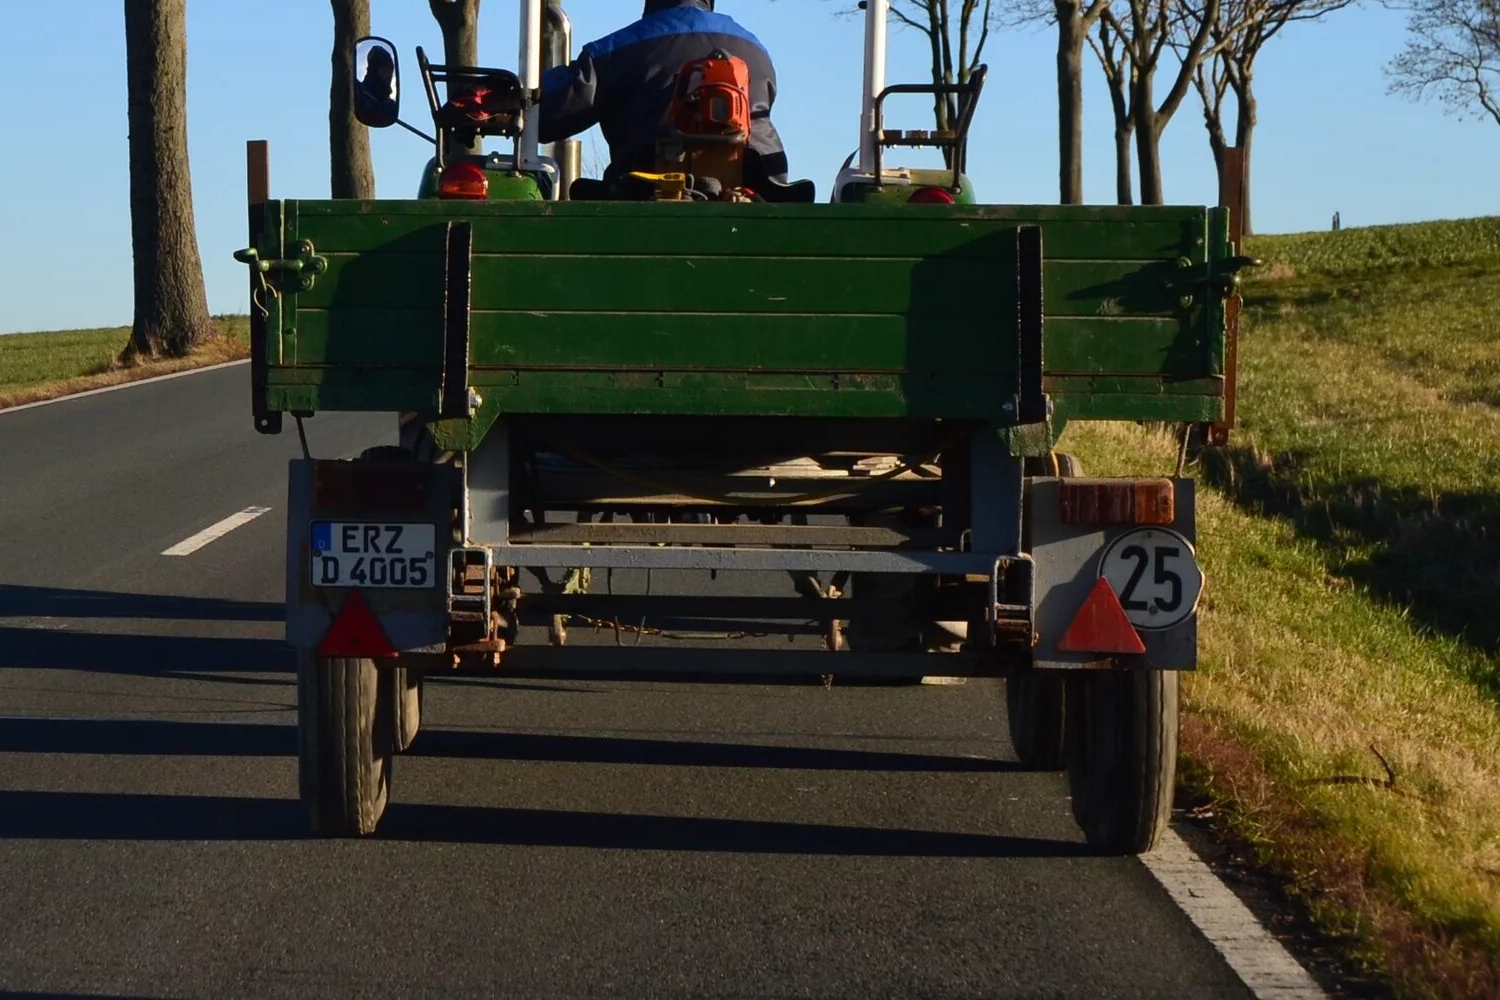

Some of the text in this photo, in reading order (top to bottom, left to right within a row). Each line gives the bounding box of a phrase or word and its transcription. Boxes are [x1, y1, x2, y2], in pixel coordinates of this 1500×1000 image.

[342, 525, 403, 553] ERZ
[321, 556, 428, 586] D 4005
[1119, 545, 1182, 612] 25
